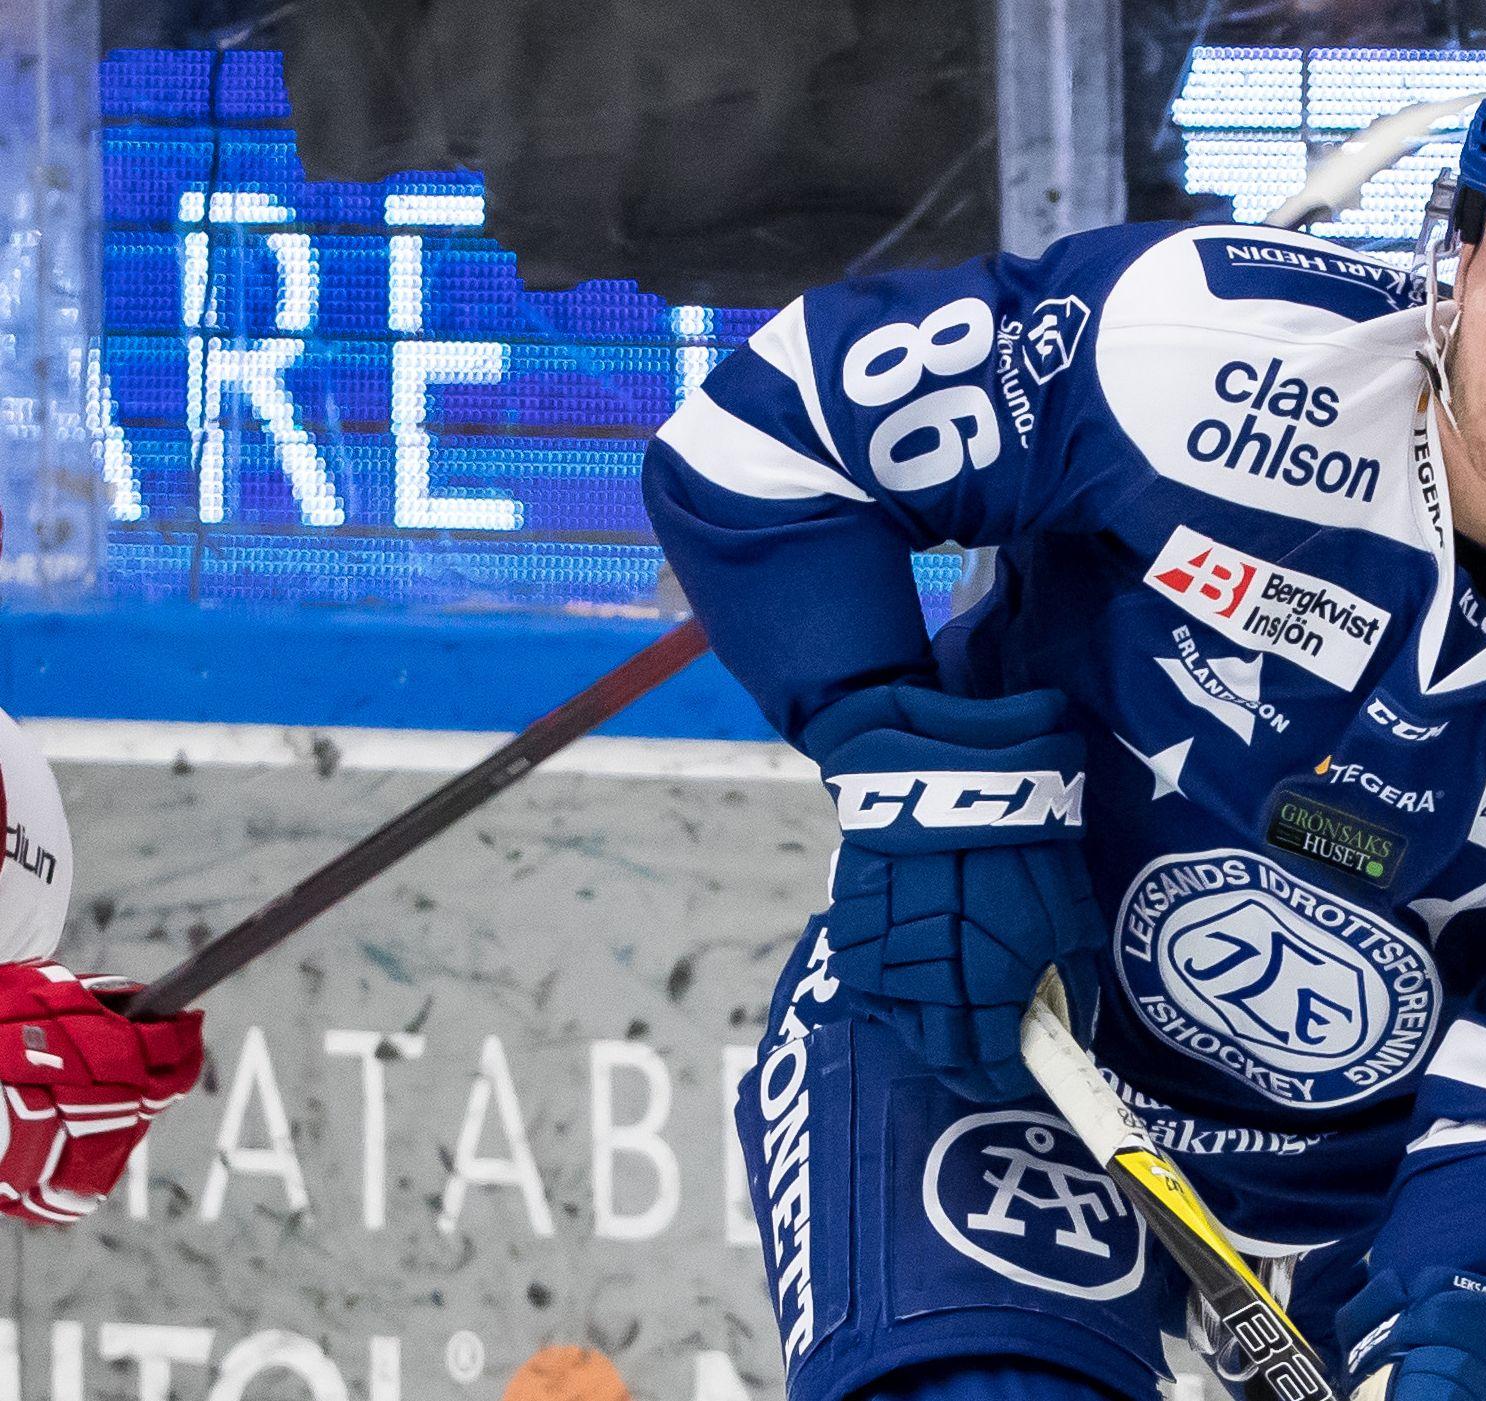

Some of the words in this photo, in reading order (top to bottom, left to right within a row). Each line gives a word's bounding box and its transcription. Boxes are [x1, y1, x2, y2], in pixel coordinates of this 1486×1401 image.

[1226, 245, 1327, 271] HEDIN
[1330, 260, 1406, 294] KARL
[842, 297, 1001, 492] 86
[1214, 357, 1340, 428] clas
[1186, 412, 1380, 502] ohlson
[1242, 606, 1323, 657] Insjön
[1261, 573, 1379, 645] Bergkvist
[1367, 698, 1449, 741] CCM
[826, 770, 1085, 830] CCM
[1280, 803, 1392, 858] GRÖNSAKS
[1303, 832, 1371, 872] HUSET
[1125, 859, 1250, 962] LEKSANDS
[1259, 864, 1428, 1086] IDROTTSFÖRENING
[1139, 995, 1316, 1101] ISHOCKEY
[127, 1023, 762, 1244] ATABE
